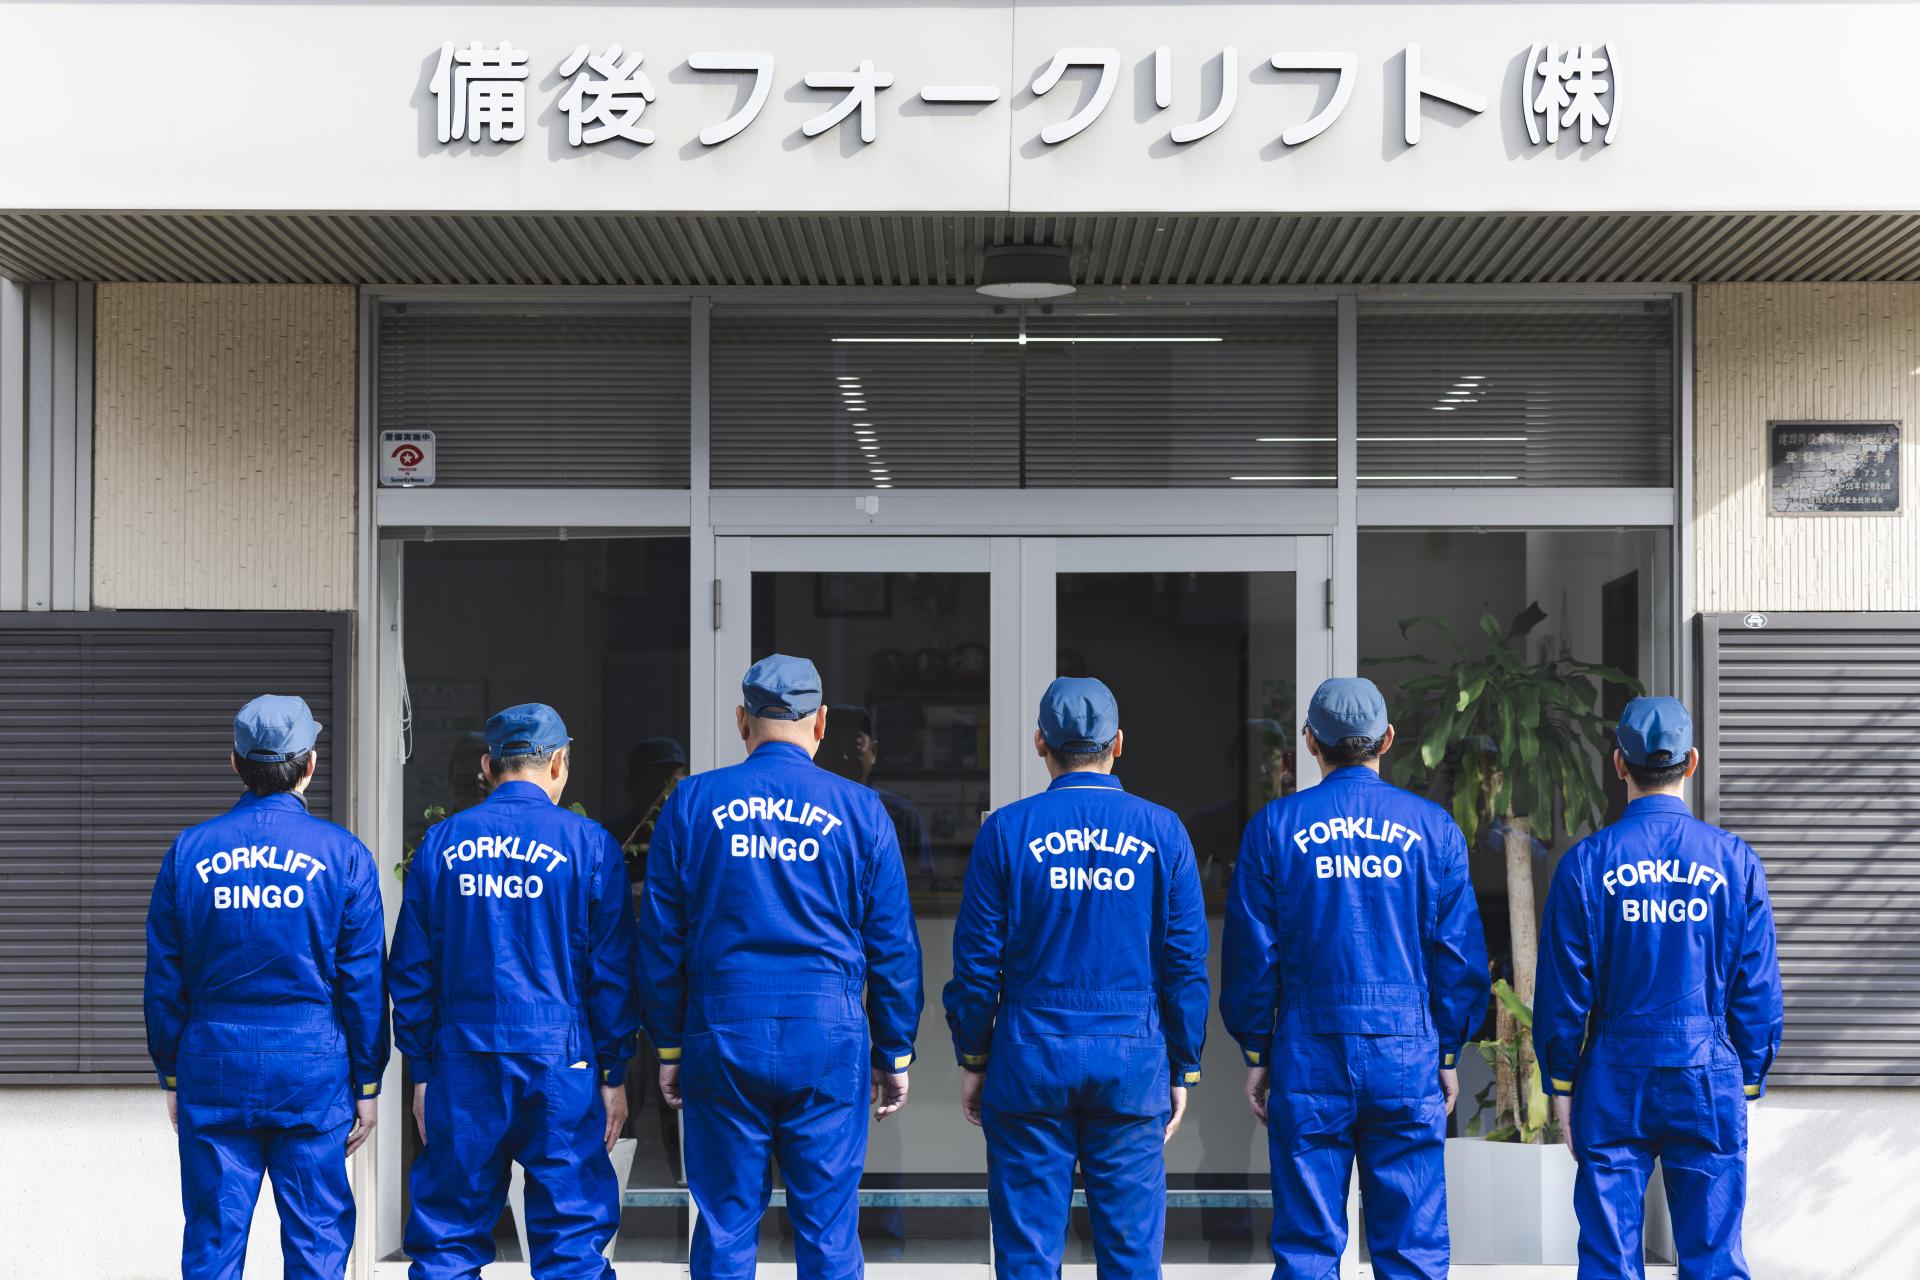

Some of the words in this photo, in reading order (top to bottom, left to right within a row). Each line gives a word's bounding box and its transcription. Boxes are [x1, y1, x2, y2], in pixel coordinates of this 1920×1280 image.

[711, 796, 843, 836] FORKLIFT
[731, 833, 820, 862] BINGO
[1028, 827, 1156, 865] FORKLIFT
[1293, 816, 1423, 854] FORKLIFT
[195, 845, 327, 884] FORKLIFT
[442, 835, 568, 873] FORKLIFT
[1315, 854, 1403, 879] BINGO
[459, 873, 544, 899] BINGO
[1049, 866, 1135, 891] BINGO
[1602, 858, 1728, 896] FORKLIFT
[213, 884, 305, 909] BINGO
[1622, 898, 1708, 924] BINGO
